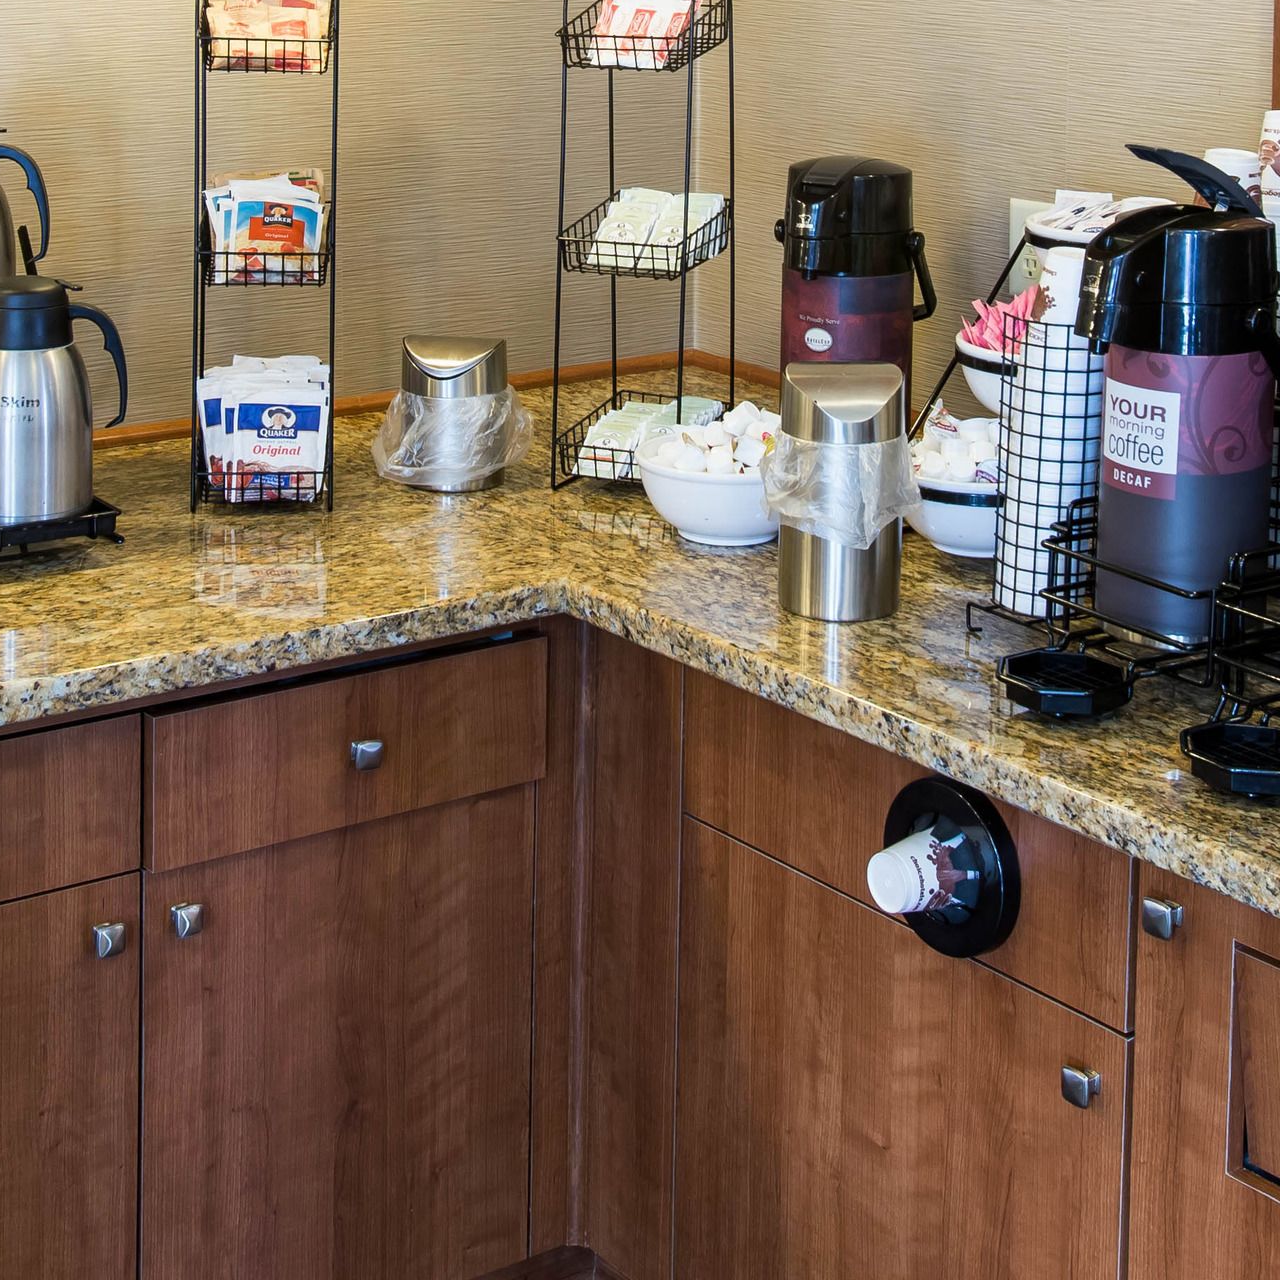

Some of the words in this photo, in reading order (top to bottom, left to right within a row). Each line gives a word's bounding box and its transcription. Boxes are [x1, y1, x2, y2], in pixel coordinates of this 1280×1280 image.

[0, 395, 41, 408] Skim
[1110, 393, 1167, 423] YOUR
[259, 428, 295, 438] QUAKER
[1109, 415, 1165, 441] morning
[252, 444, 302, 457] Original
[1108, 432, 1164, 466] coffee
[1113, 467, 1152, 489] DECAF
